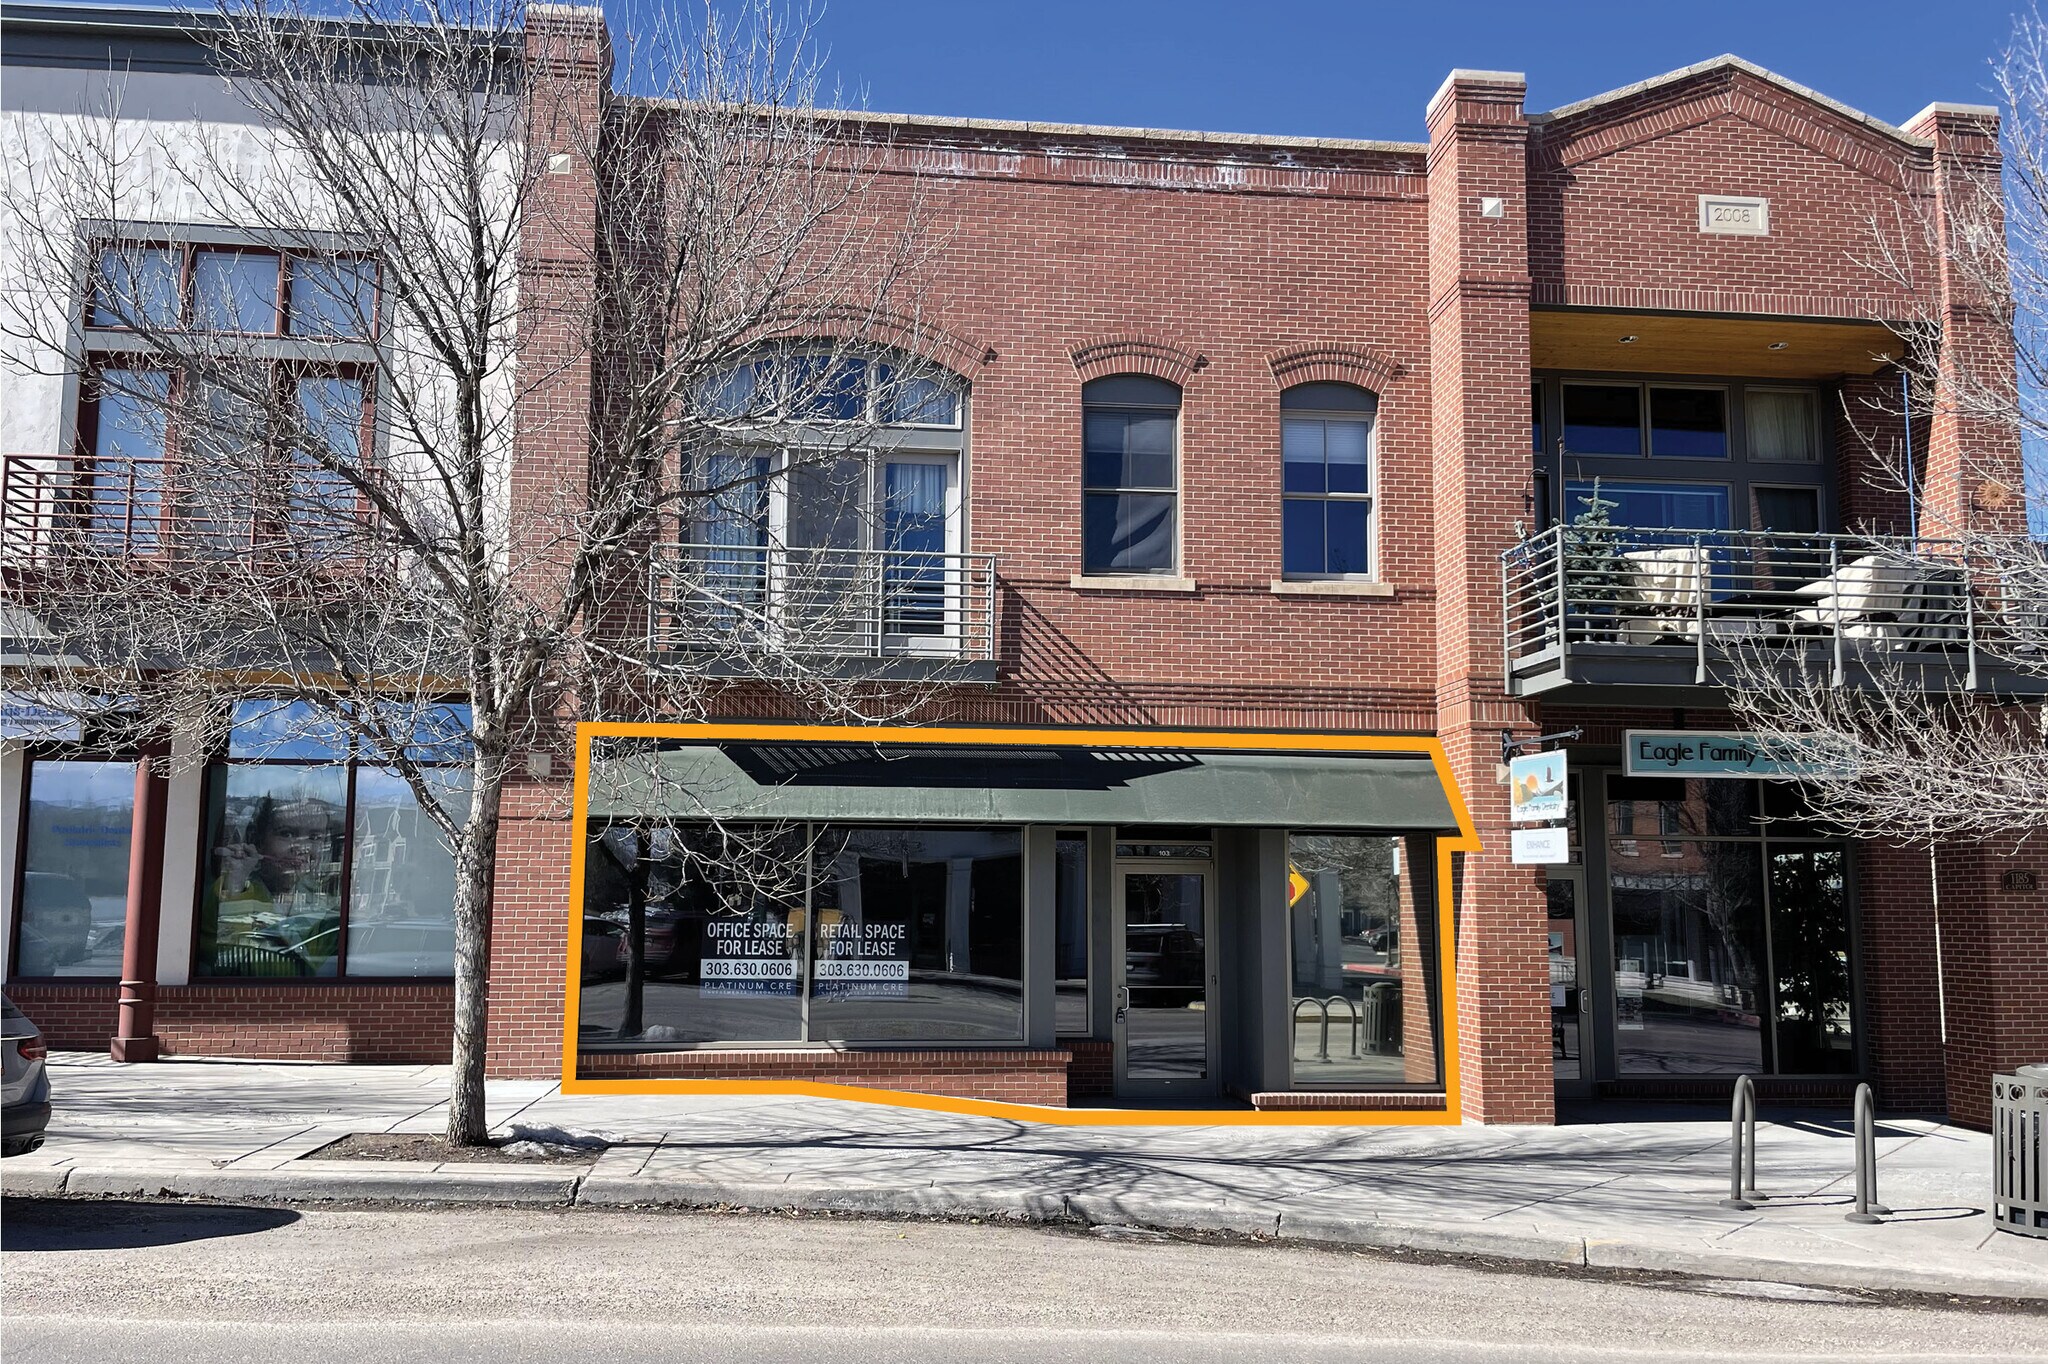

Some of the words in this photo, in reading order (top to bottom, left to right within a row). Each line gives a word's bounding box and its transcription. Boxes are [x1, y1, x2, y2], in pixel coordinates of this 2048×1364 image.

[1714, 208, 1751, 223] 2008
[1640, 741, 1694, 766] Eagle
[1699, 743, 1760, 767] Family
[2011, 872, 2030, 884] 1185
[707, 922, 751, 938] OFFICE
[753, 923, 794, 938] SPACE
[820, 923, 862, 939] RETAIL
[864, 924, 905, 939] SPACE
[716, 939, 742, 955] FOR
[744, 940, 783, 956] LEASE
[829, 940, 853, 956] FOR
[857, 941, 896, 956] LEASE
[705, 962, 793, 976] 303.630.0606
[819, 963, 905, 977] 303.630.0606
[704, 981, 764, 990] PLATINUM
[770, 981, 792, 990] CRE
[818, 982, 877, 991] PLATINUM
[882, 983, 904, 991] CRE
